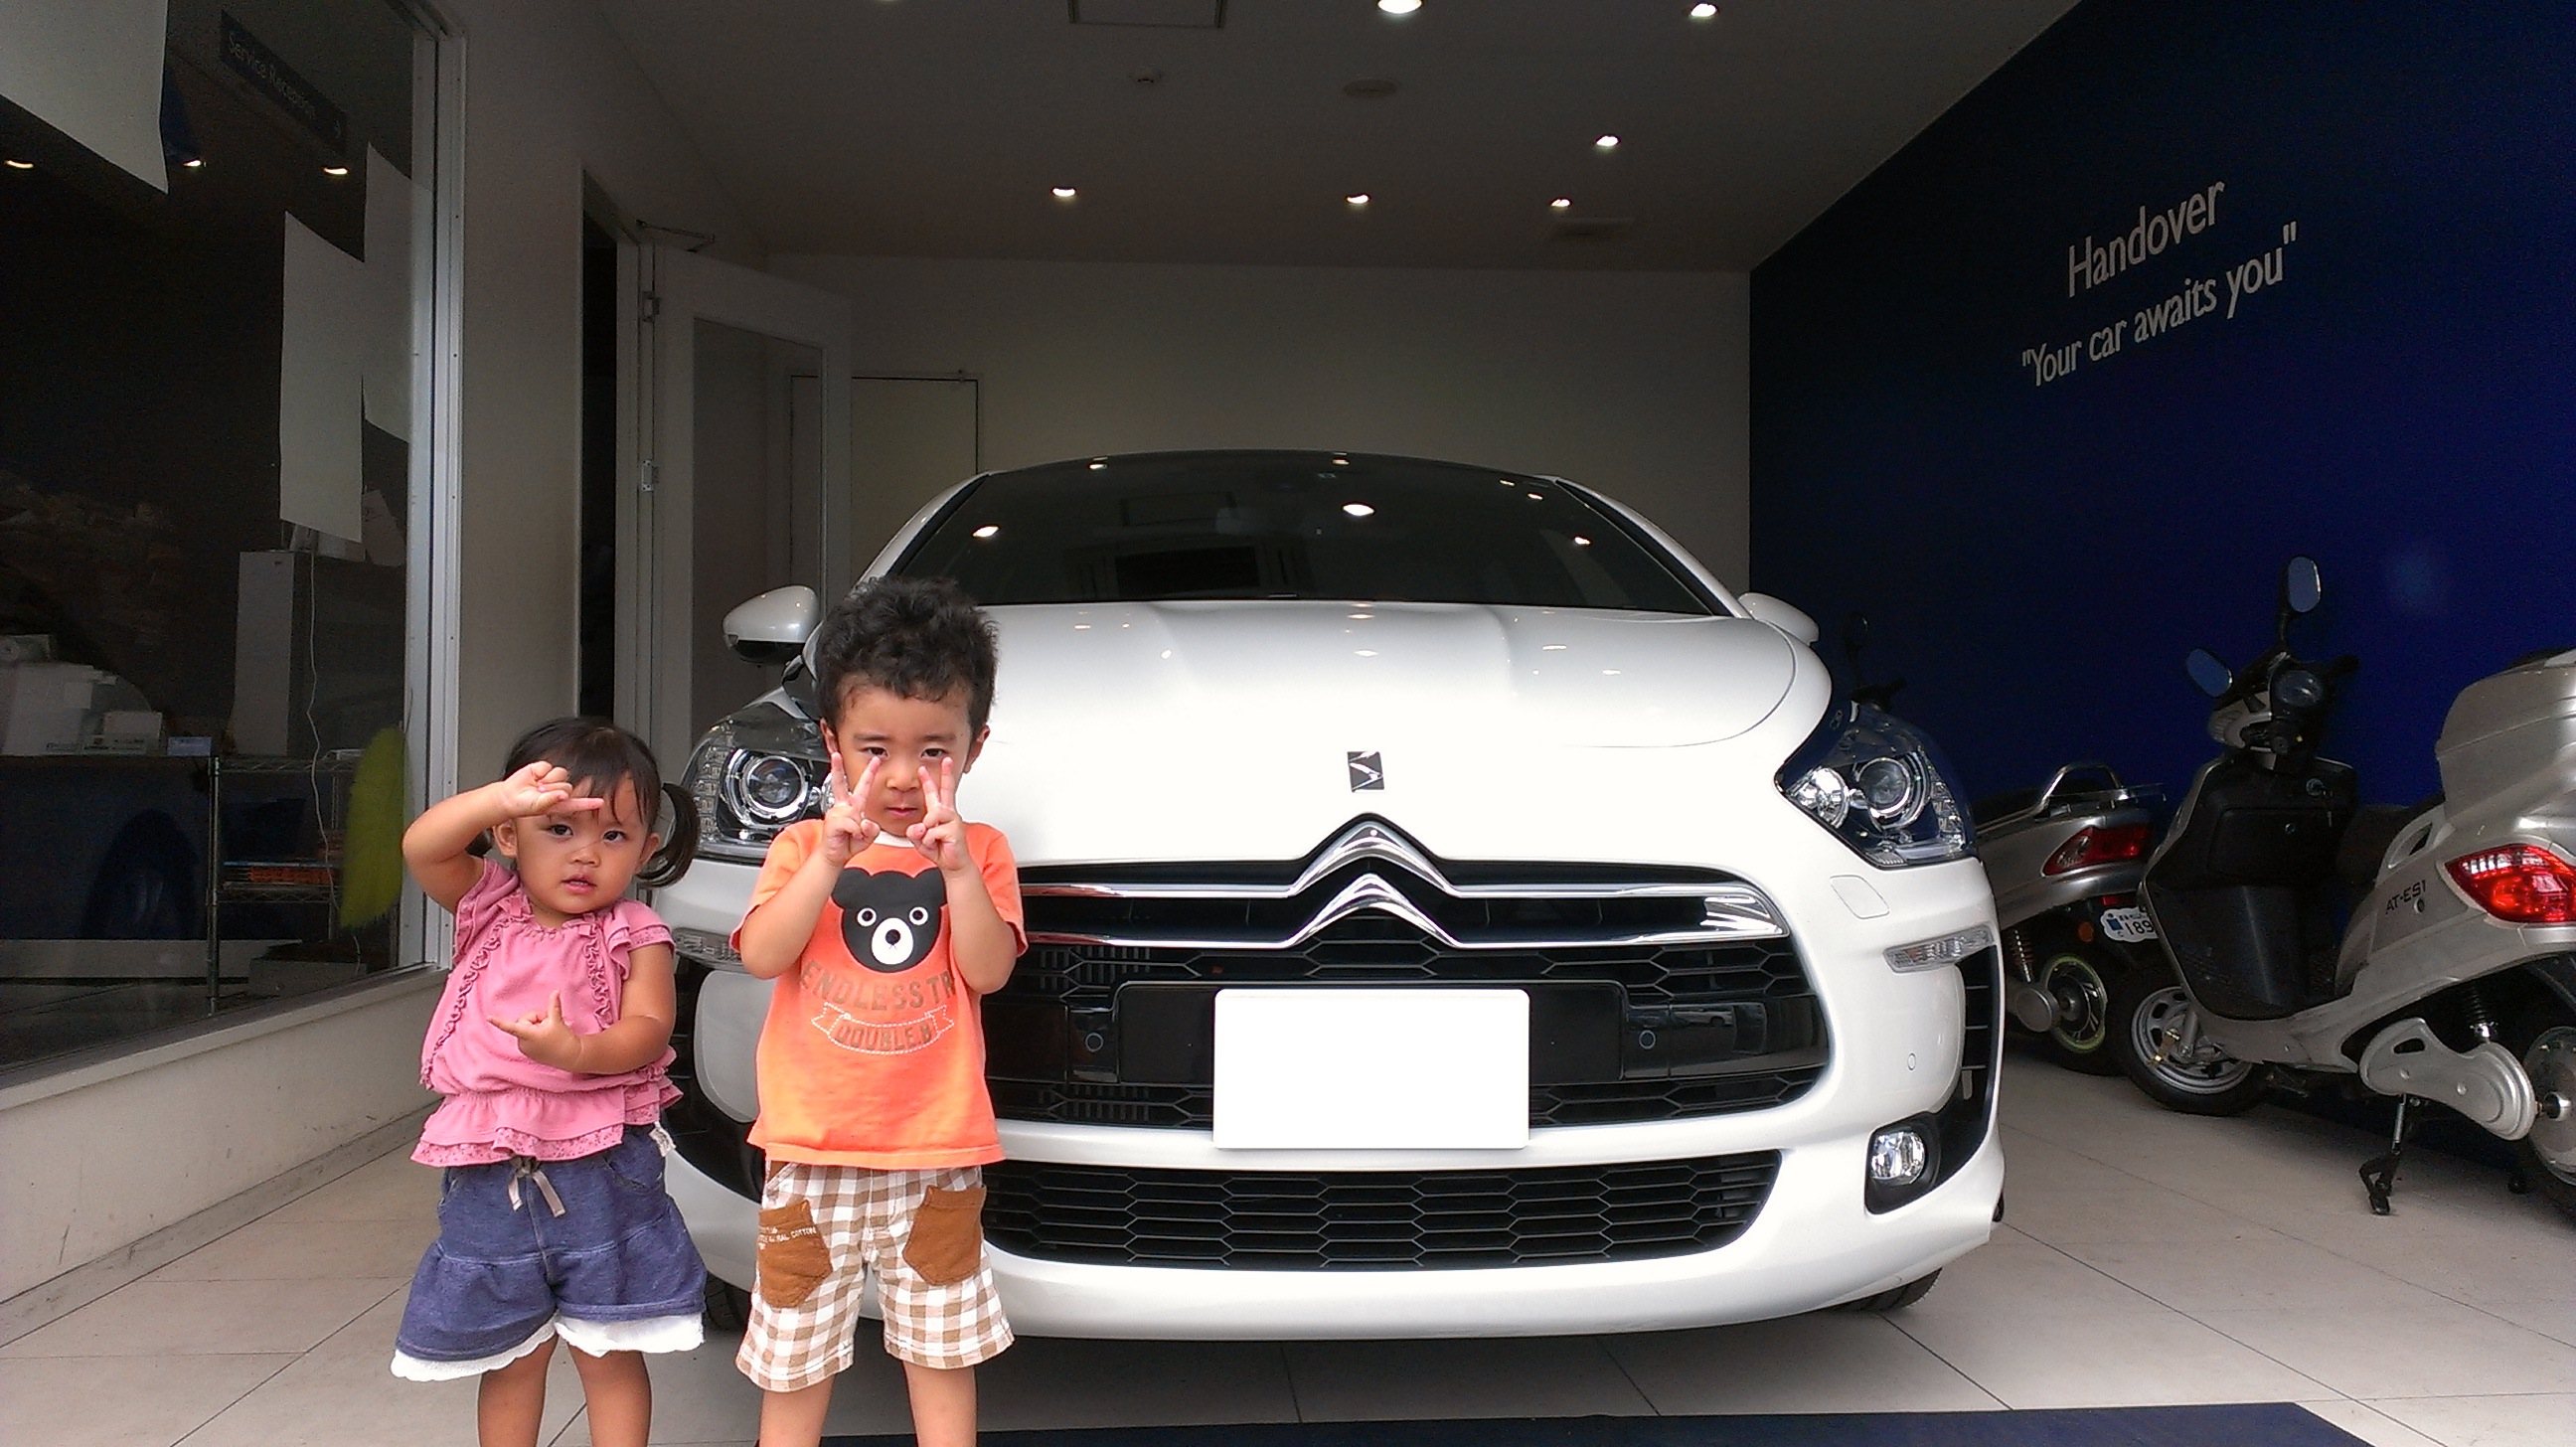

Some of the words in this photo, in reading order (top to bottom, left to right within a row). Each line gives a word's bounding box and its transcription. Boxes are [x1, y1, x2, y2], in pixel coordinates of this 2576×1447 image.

[2021, 340, 2083, 387] "Your
[2089, 319, 2128, 372] car
[2134, 277, 2217, 344] awaits
[2225, 220, 2298, 320] you"
[2068, 180, 2225, 298] Handover
